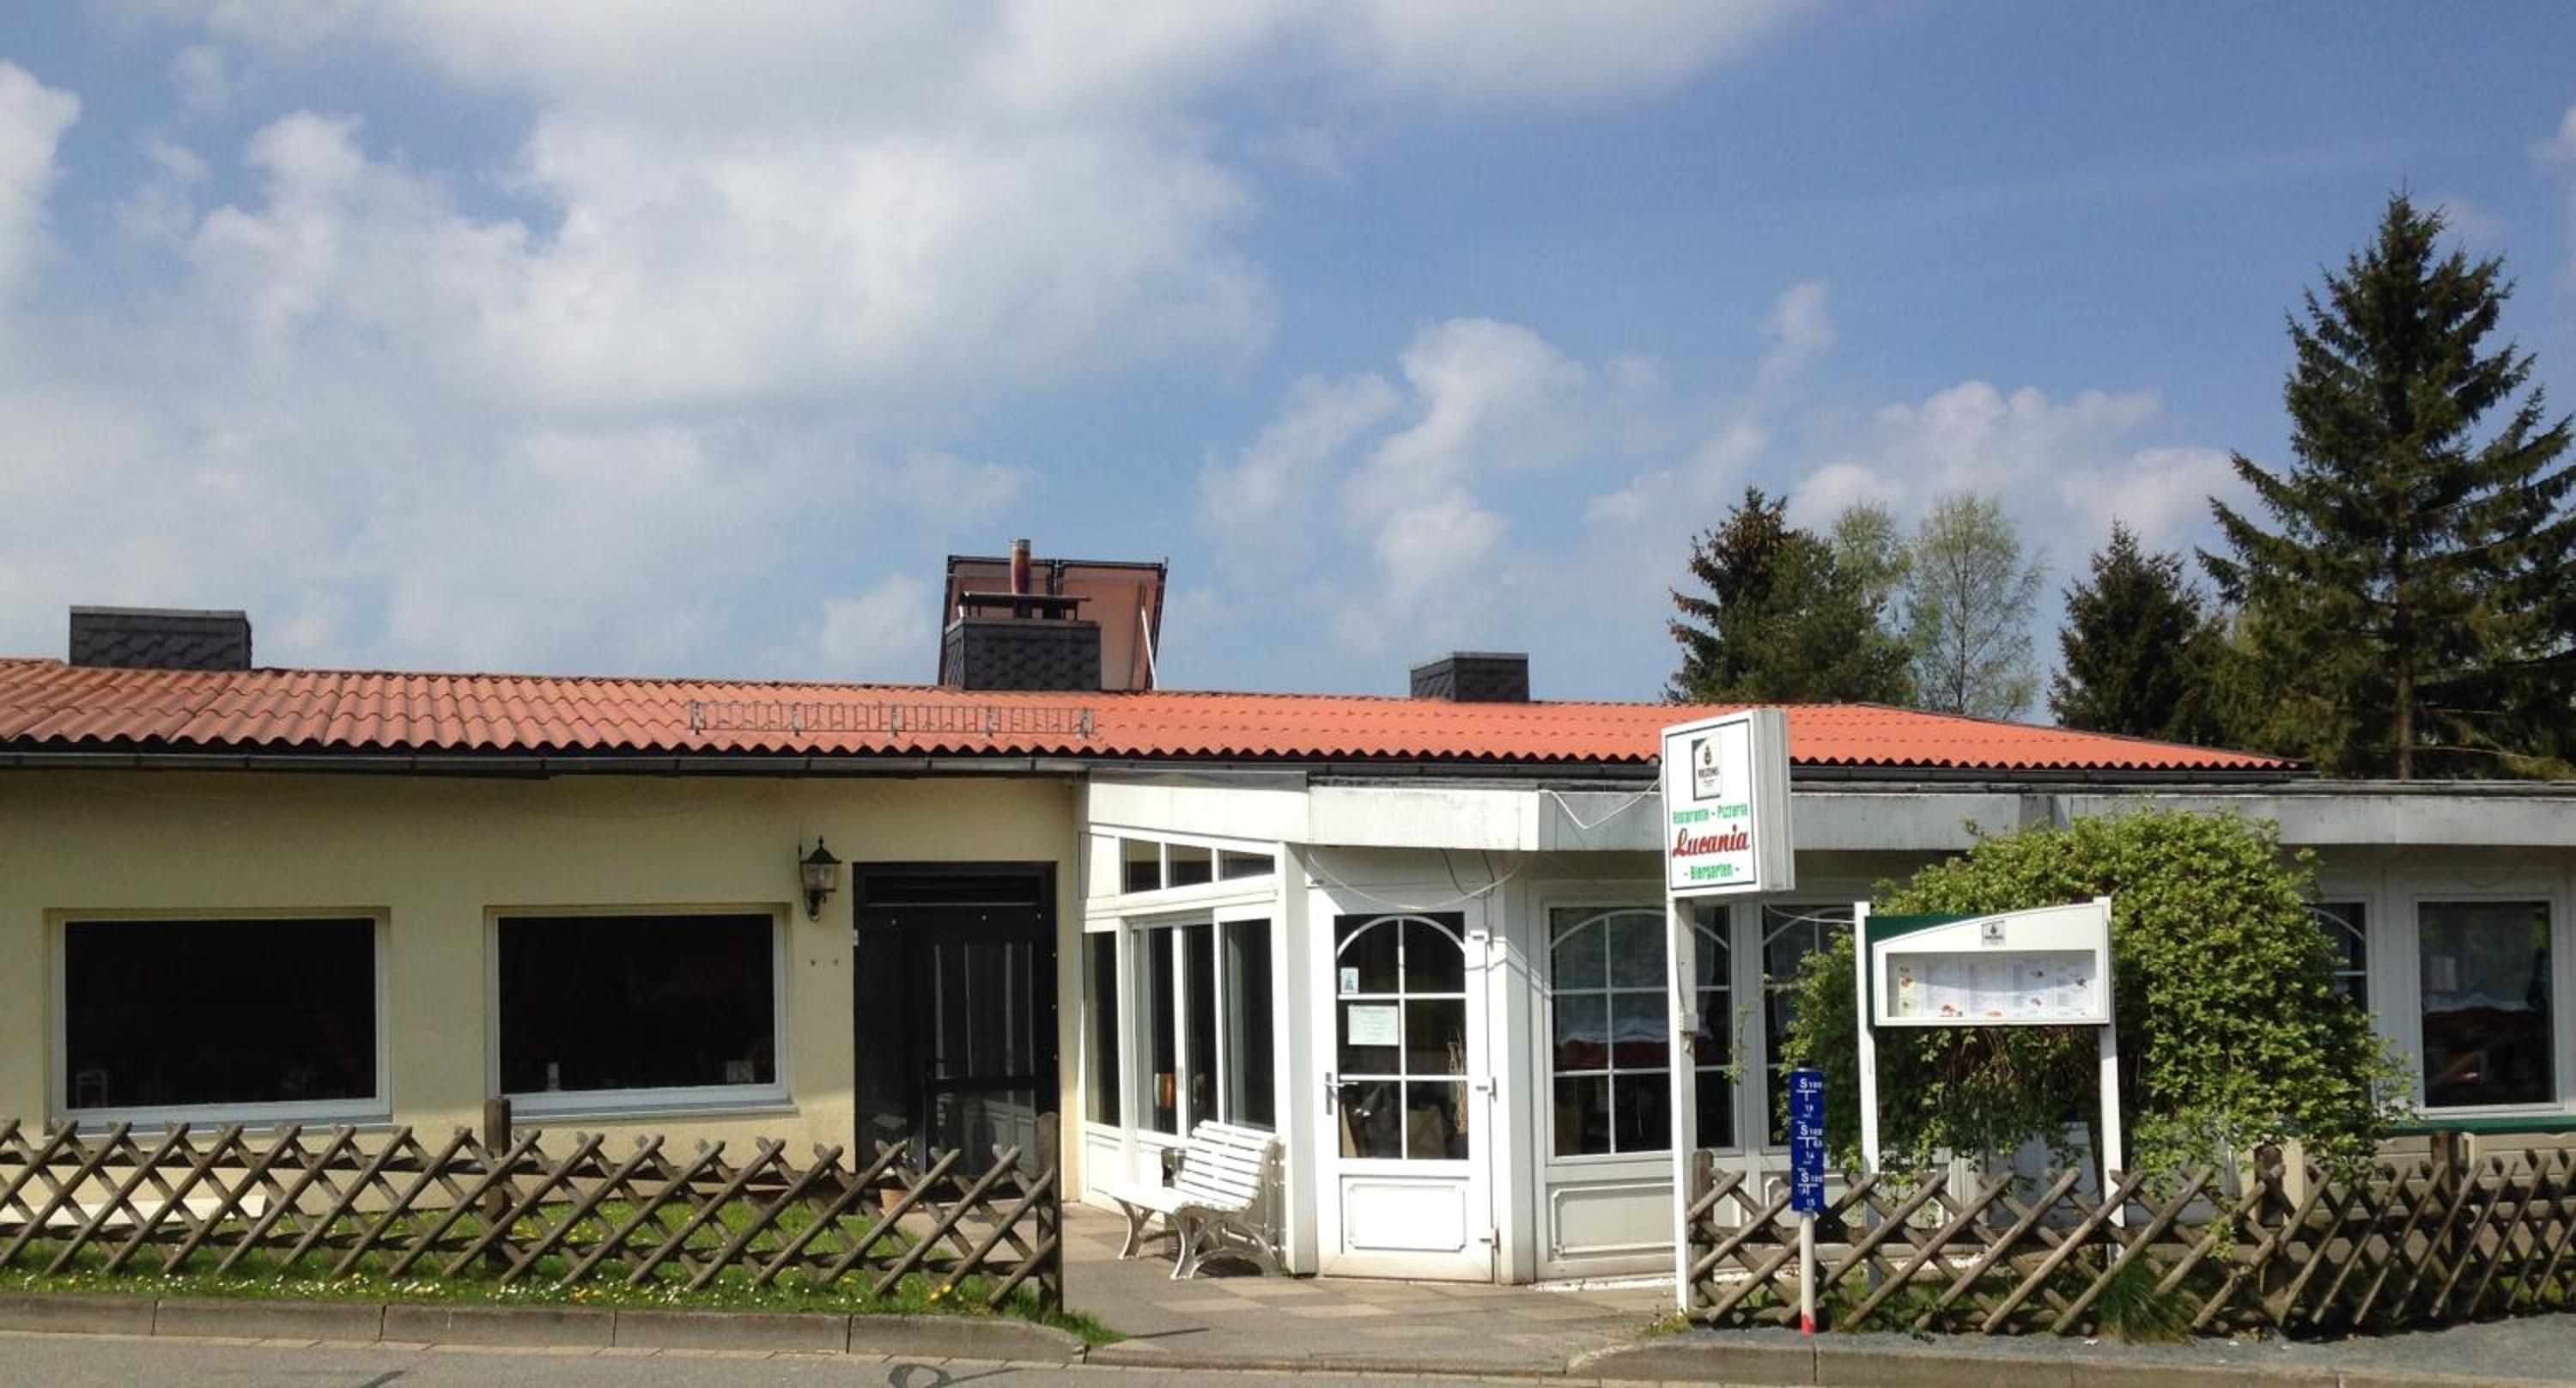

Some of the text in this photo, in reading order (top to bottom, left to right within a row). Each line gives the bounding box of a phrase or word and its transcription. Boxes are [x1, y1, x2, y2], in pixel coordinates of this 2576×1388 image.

[1717, 803, 1748, 819] Pizzeria
[1672, 824, 1750, 858] Lucania
[1690, 863, 1733, 880] Biergarten
